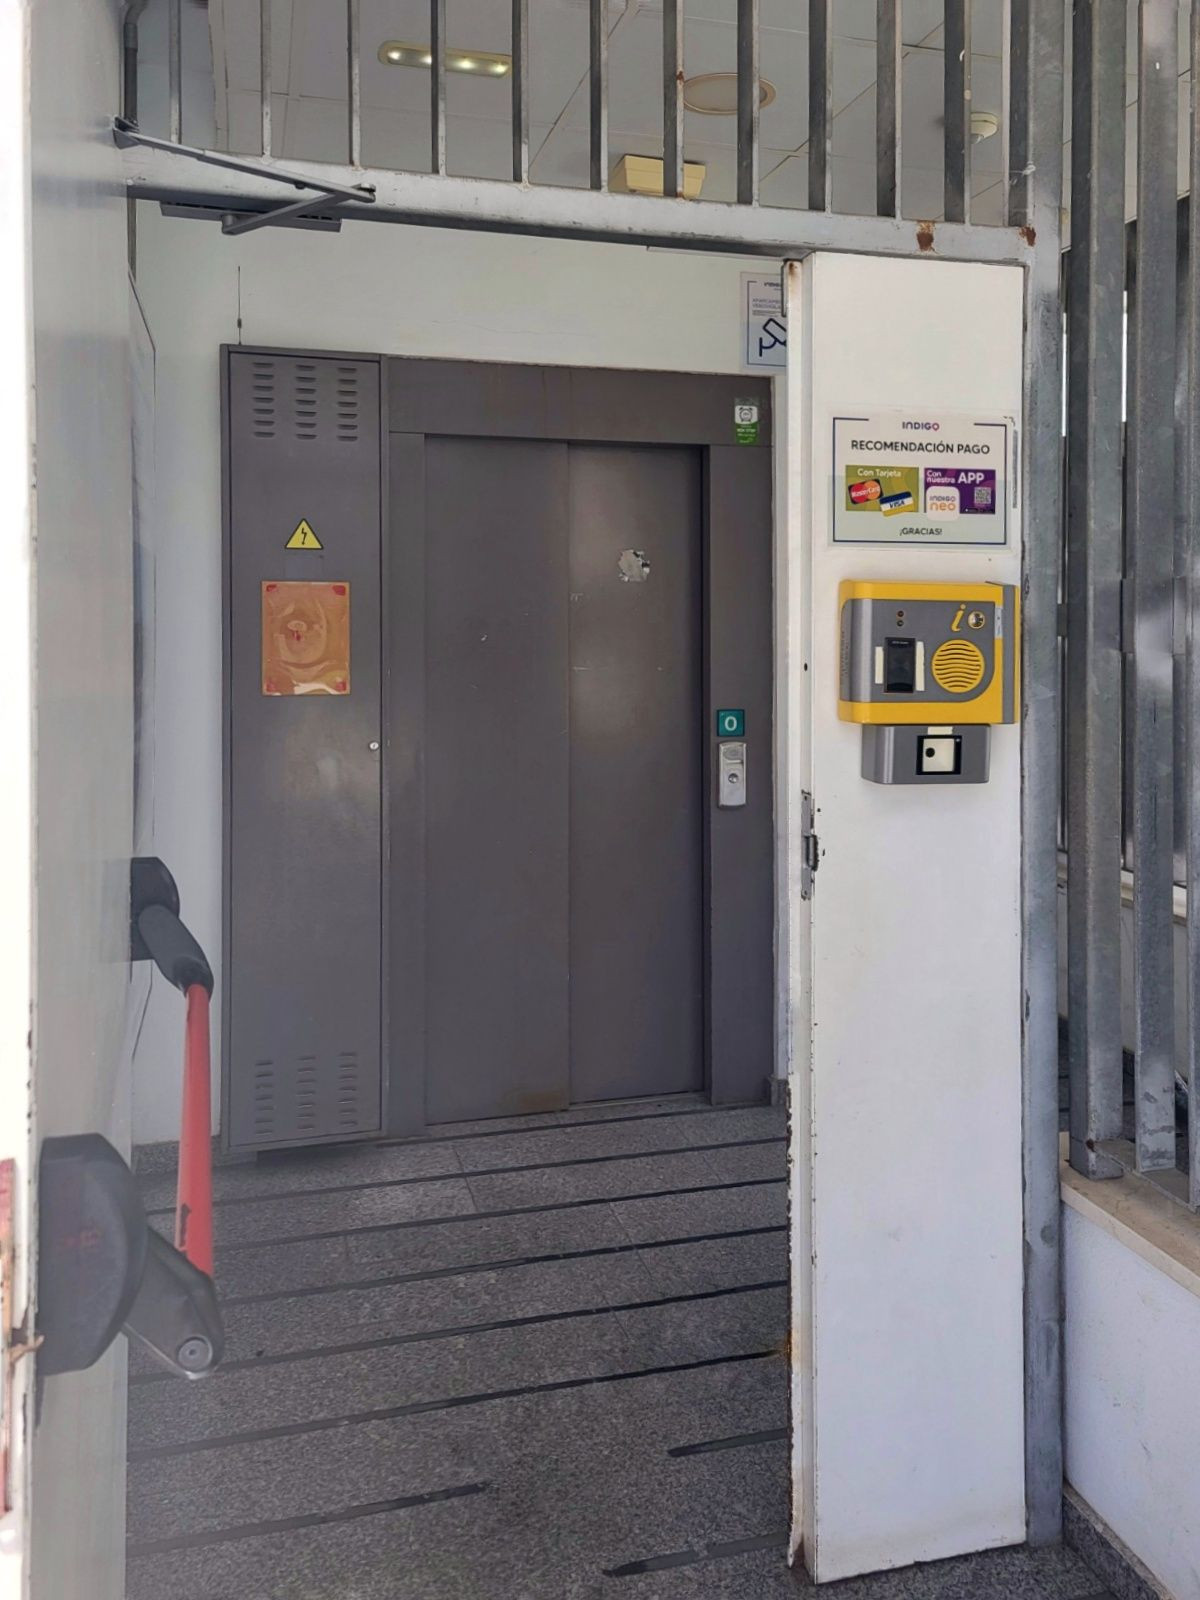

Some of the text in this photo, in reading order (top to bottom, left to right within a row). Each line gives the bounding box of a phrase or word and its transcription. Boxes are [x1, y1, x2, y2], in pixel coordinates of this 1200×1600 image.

[902, 421, 940, 432] INDIGO
[851, 439, 990, 455] RECOMENDACIÓN PAGO
[857, 468, 902, 479] Con Tarjeta
[926, 469, 942, 478] Con
[957, 471, 985, 485] APP
[889, 500, 905, 509] VISA
[929, 502, 956, 511] neo
[899, 527, 943, 536] ¡GRACIAS!
